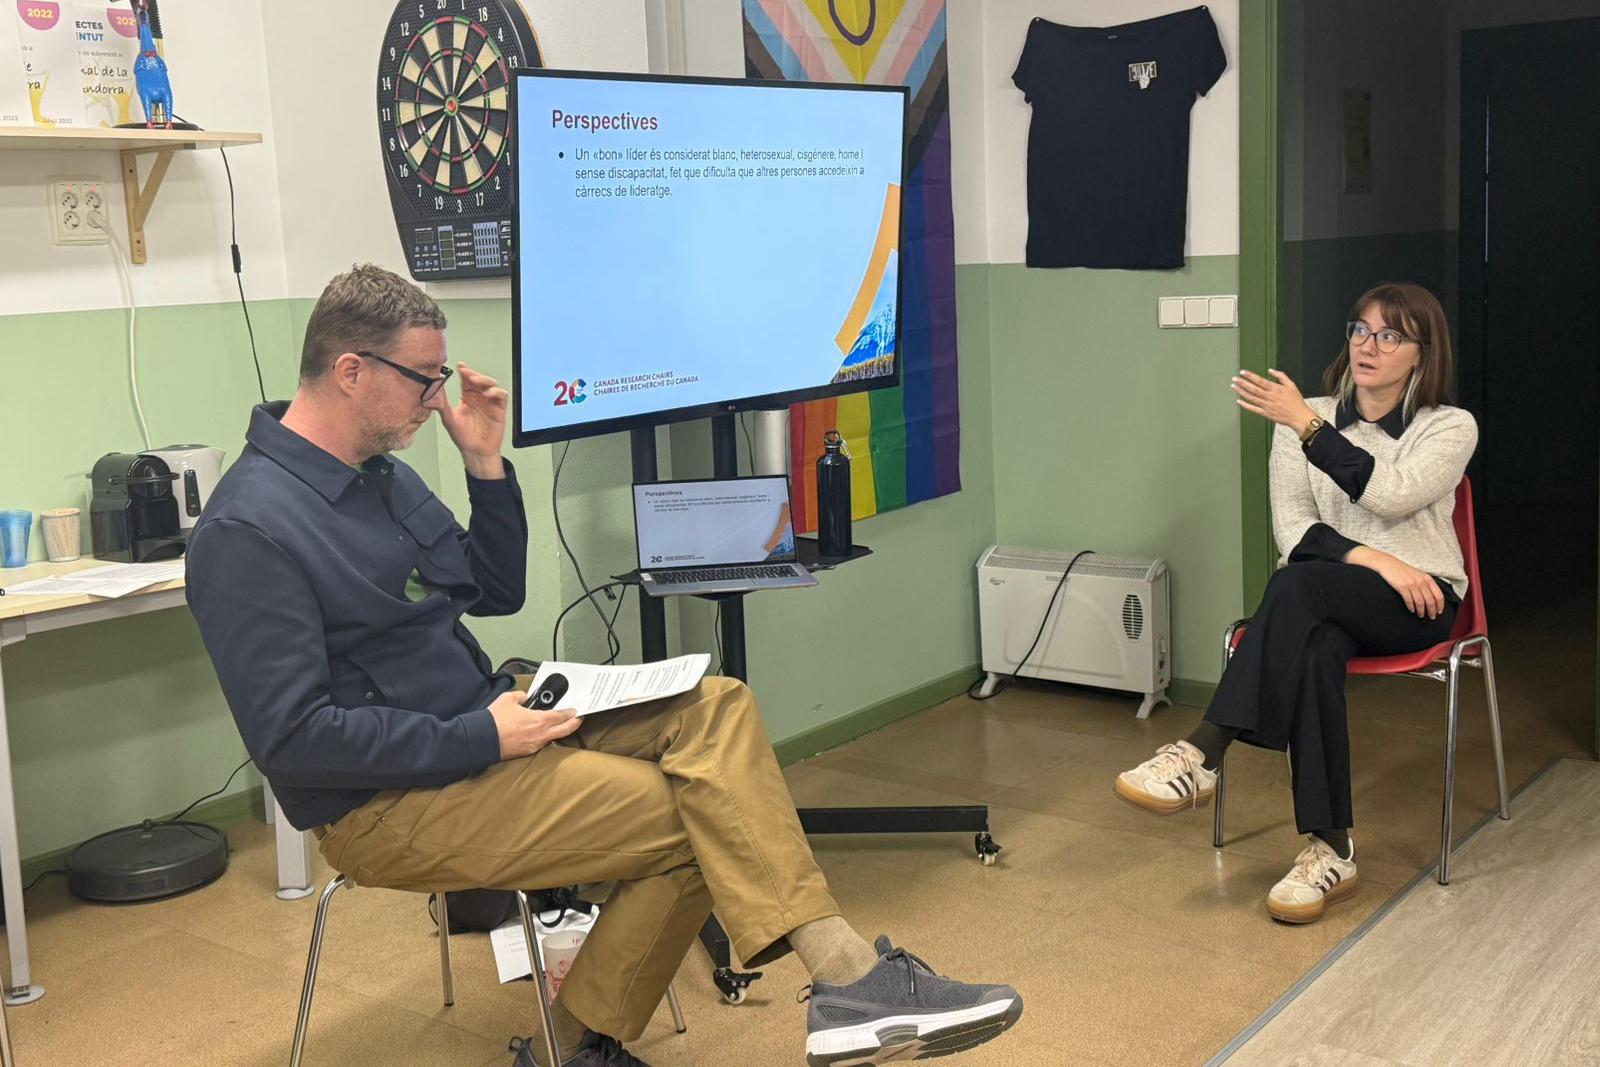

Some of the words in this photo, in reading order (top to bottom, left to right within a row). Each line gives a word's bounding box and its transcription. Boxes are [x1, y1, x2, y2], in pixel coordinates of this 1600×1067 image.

[27, 8, 53, 19] 2022
[419, 5, 425, 18] 5
[478, 7, 488, 22] 18
[400, 22, 409, 36] 12
[497, 28, 504, 42] 4
[390, 47, 396, 61] 9
[508, 56, 518, 69] 13
[101, 65, 114, 77] de
[117, 67, 128, 78] la
[382, 77, 392, 91] 14
[382, 108, 391, 122] 11
[552, 109, 658, 134] Perspectives
[389, 137, 395, 151] 8
[575, 148, 590, 160] Un
[593, 148, 623, 160] «bon»
[626, 148, 647, 160] líder
[650, 148, 662, 160] és
[663, 148, 710, 160] considerat
[712, 148, 738, 162] blanc,
[741, 148, 794, 161] heterosexual,
[839, 149, 859, 160] home
[399, 164, 409, 178] 16
[575, 168, 605, 179] sense
[608, 167, 667, 180] discapacitat,
[670, 166, 681, 178] fet
[684, 169, 700, 180] que
[703, 166, 736, 178] dificulta
[738, 168, 754, 180] que
[756, 166, 779, 177] altres
[781, 166, 817, 179] persones
[818, 165, 858, 176] accedeixin
[859, 167, 864, 175] a
[494, 176, 501, 190] 2
[417, 185, 422, 198] 7
[575, 185, 612, 198] càrrecs
[615, 185, 627, 197] de
[630, 184, 672, 199] lideratge.
[434, 196, 444, 210] 19
[457, 199, 463, 213] 3
[475, 192, 484, 206] 17
[594, 379, 620, 388] CANADA
[620, 374, 651, 384] RESEARCH
[652, 371, 673, 380] CHAIRS
[594, 386, 620, 396] CHAIRES
[630, 380, 665, 391] RECHERCHE
[675, 376, 699, 385] CANADA
